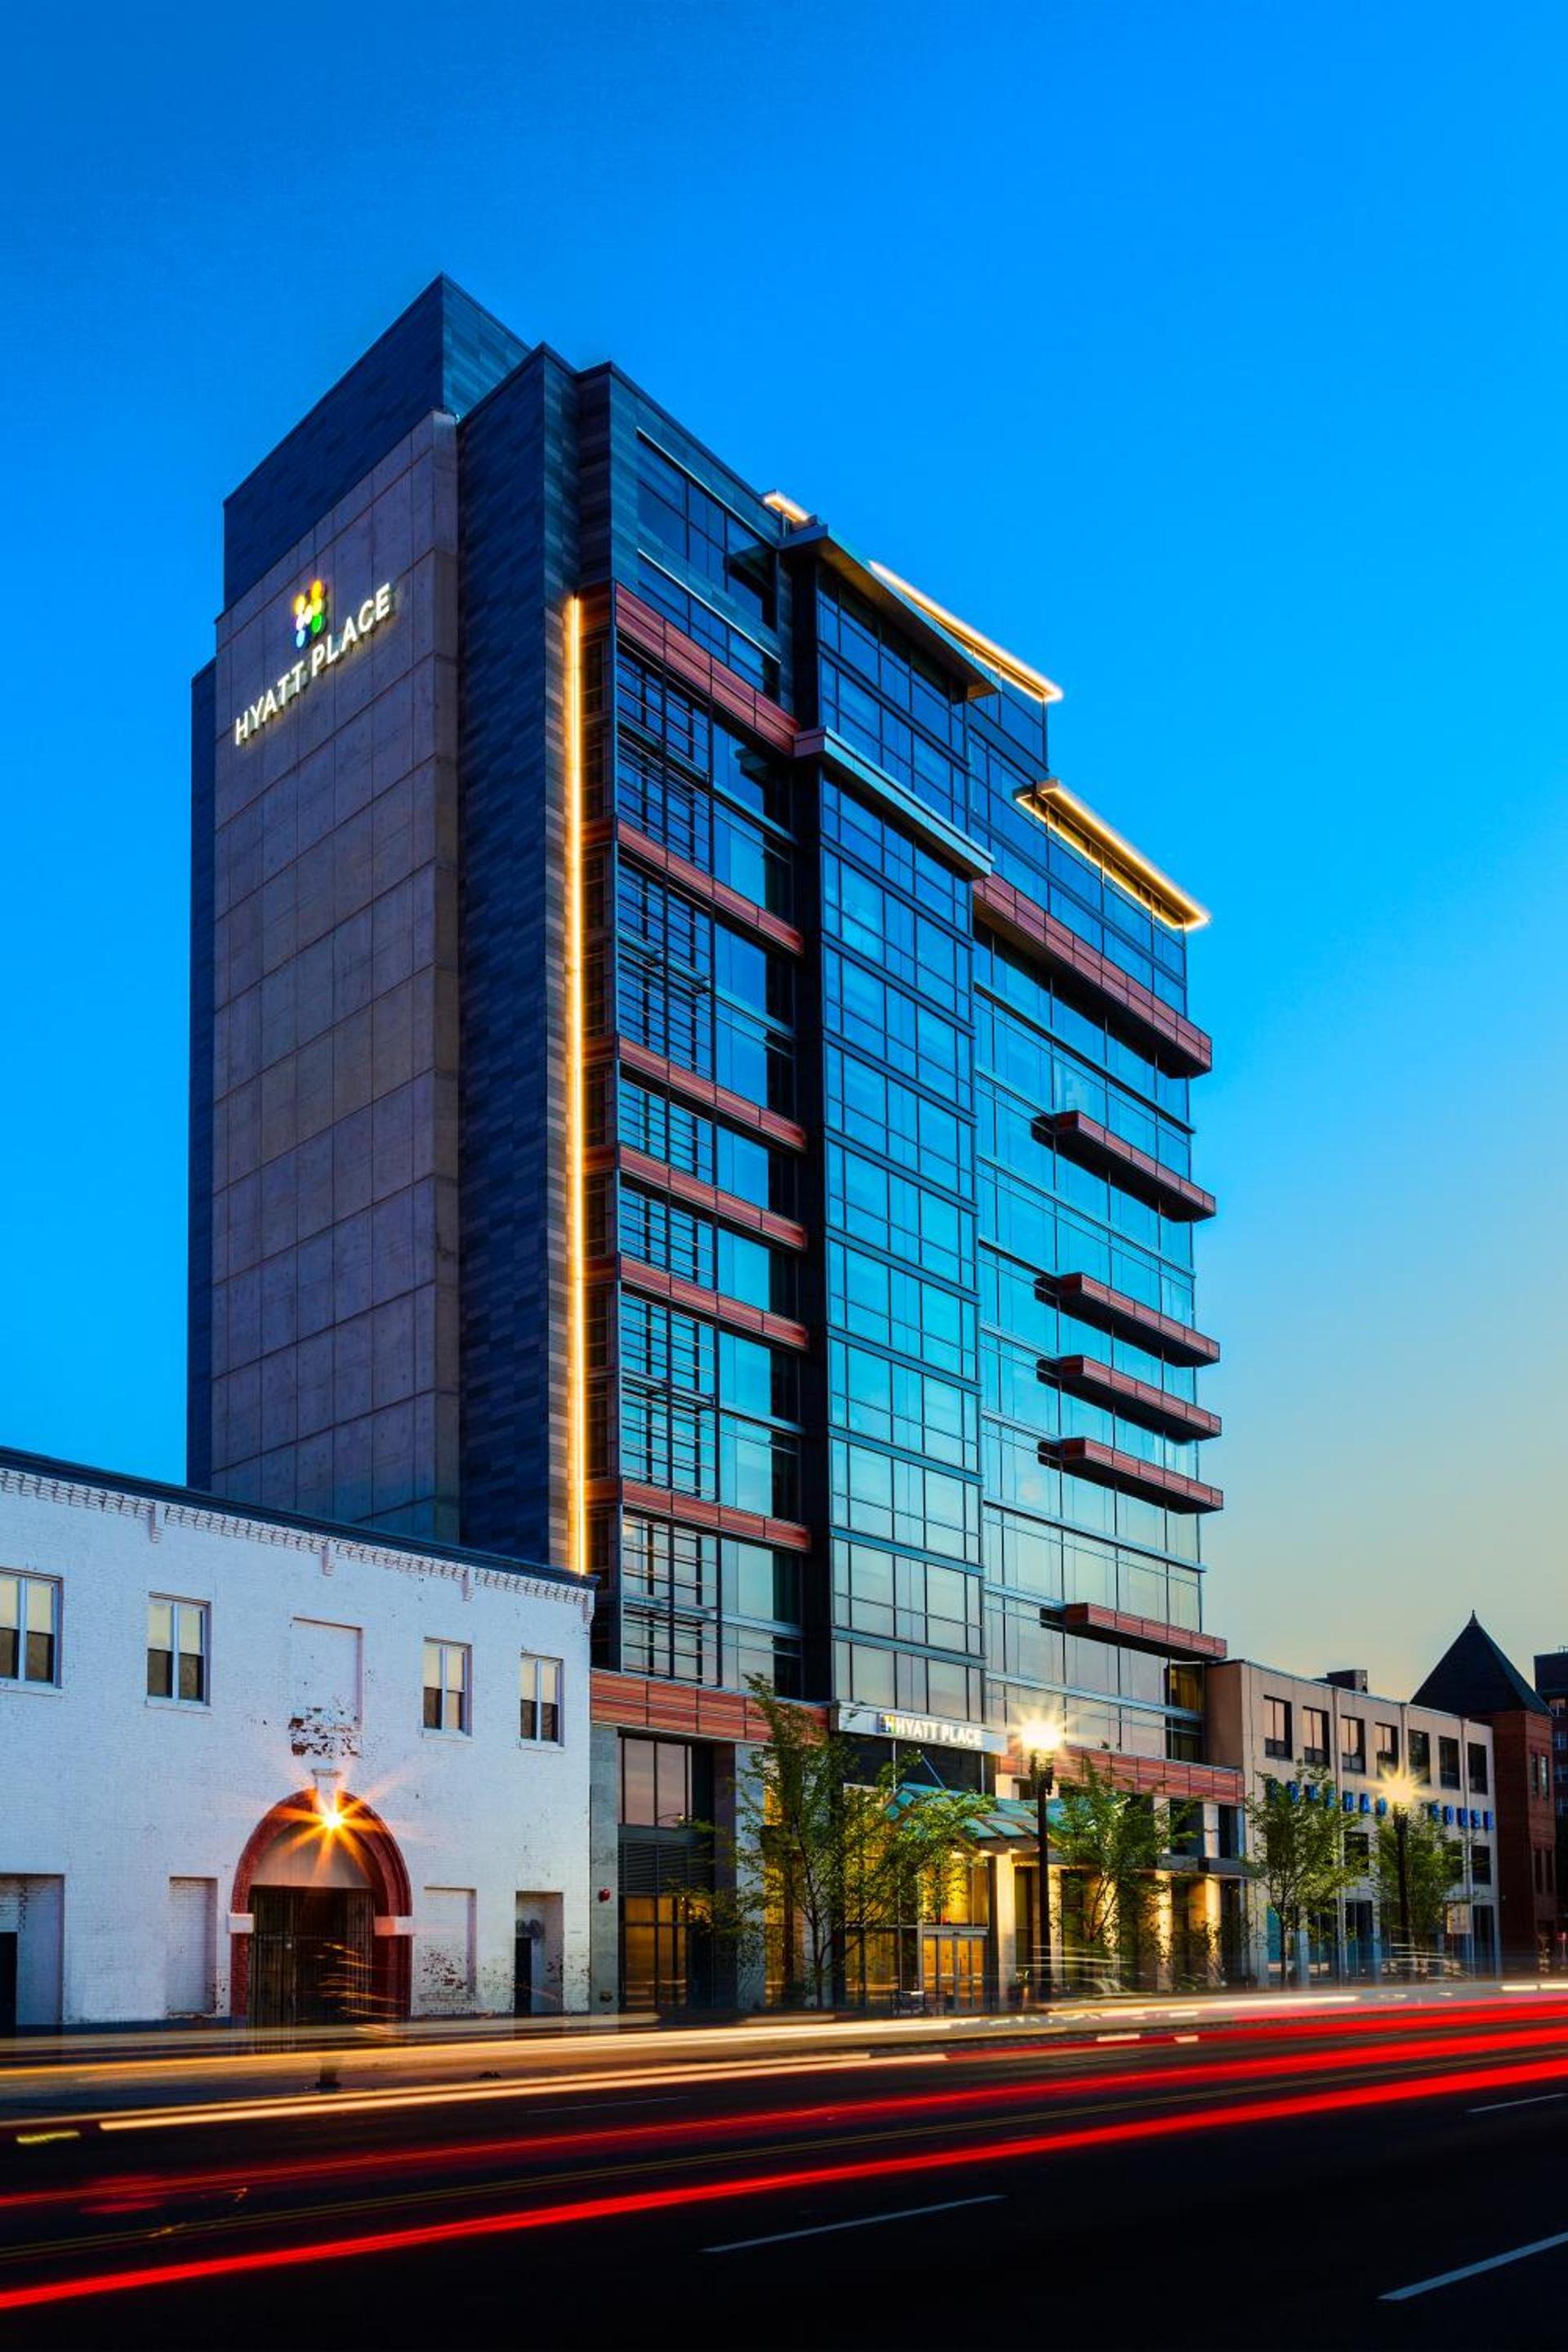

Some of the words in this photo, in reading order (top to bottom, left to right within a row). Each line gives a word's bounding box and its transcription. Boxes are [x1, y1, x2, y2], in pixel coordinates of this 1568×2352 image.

[235, 660, 305, 746] HYATT
[311, 582, 390, 677] PLACE
[897, 1716, 939, 1740] HYATT
[941, 1724, 981, 1746] PLACE
